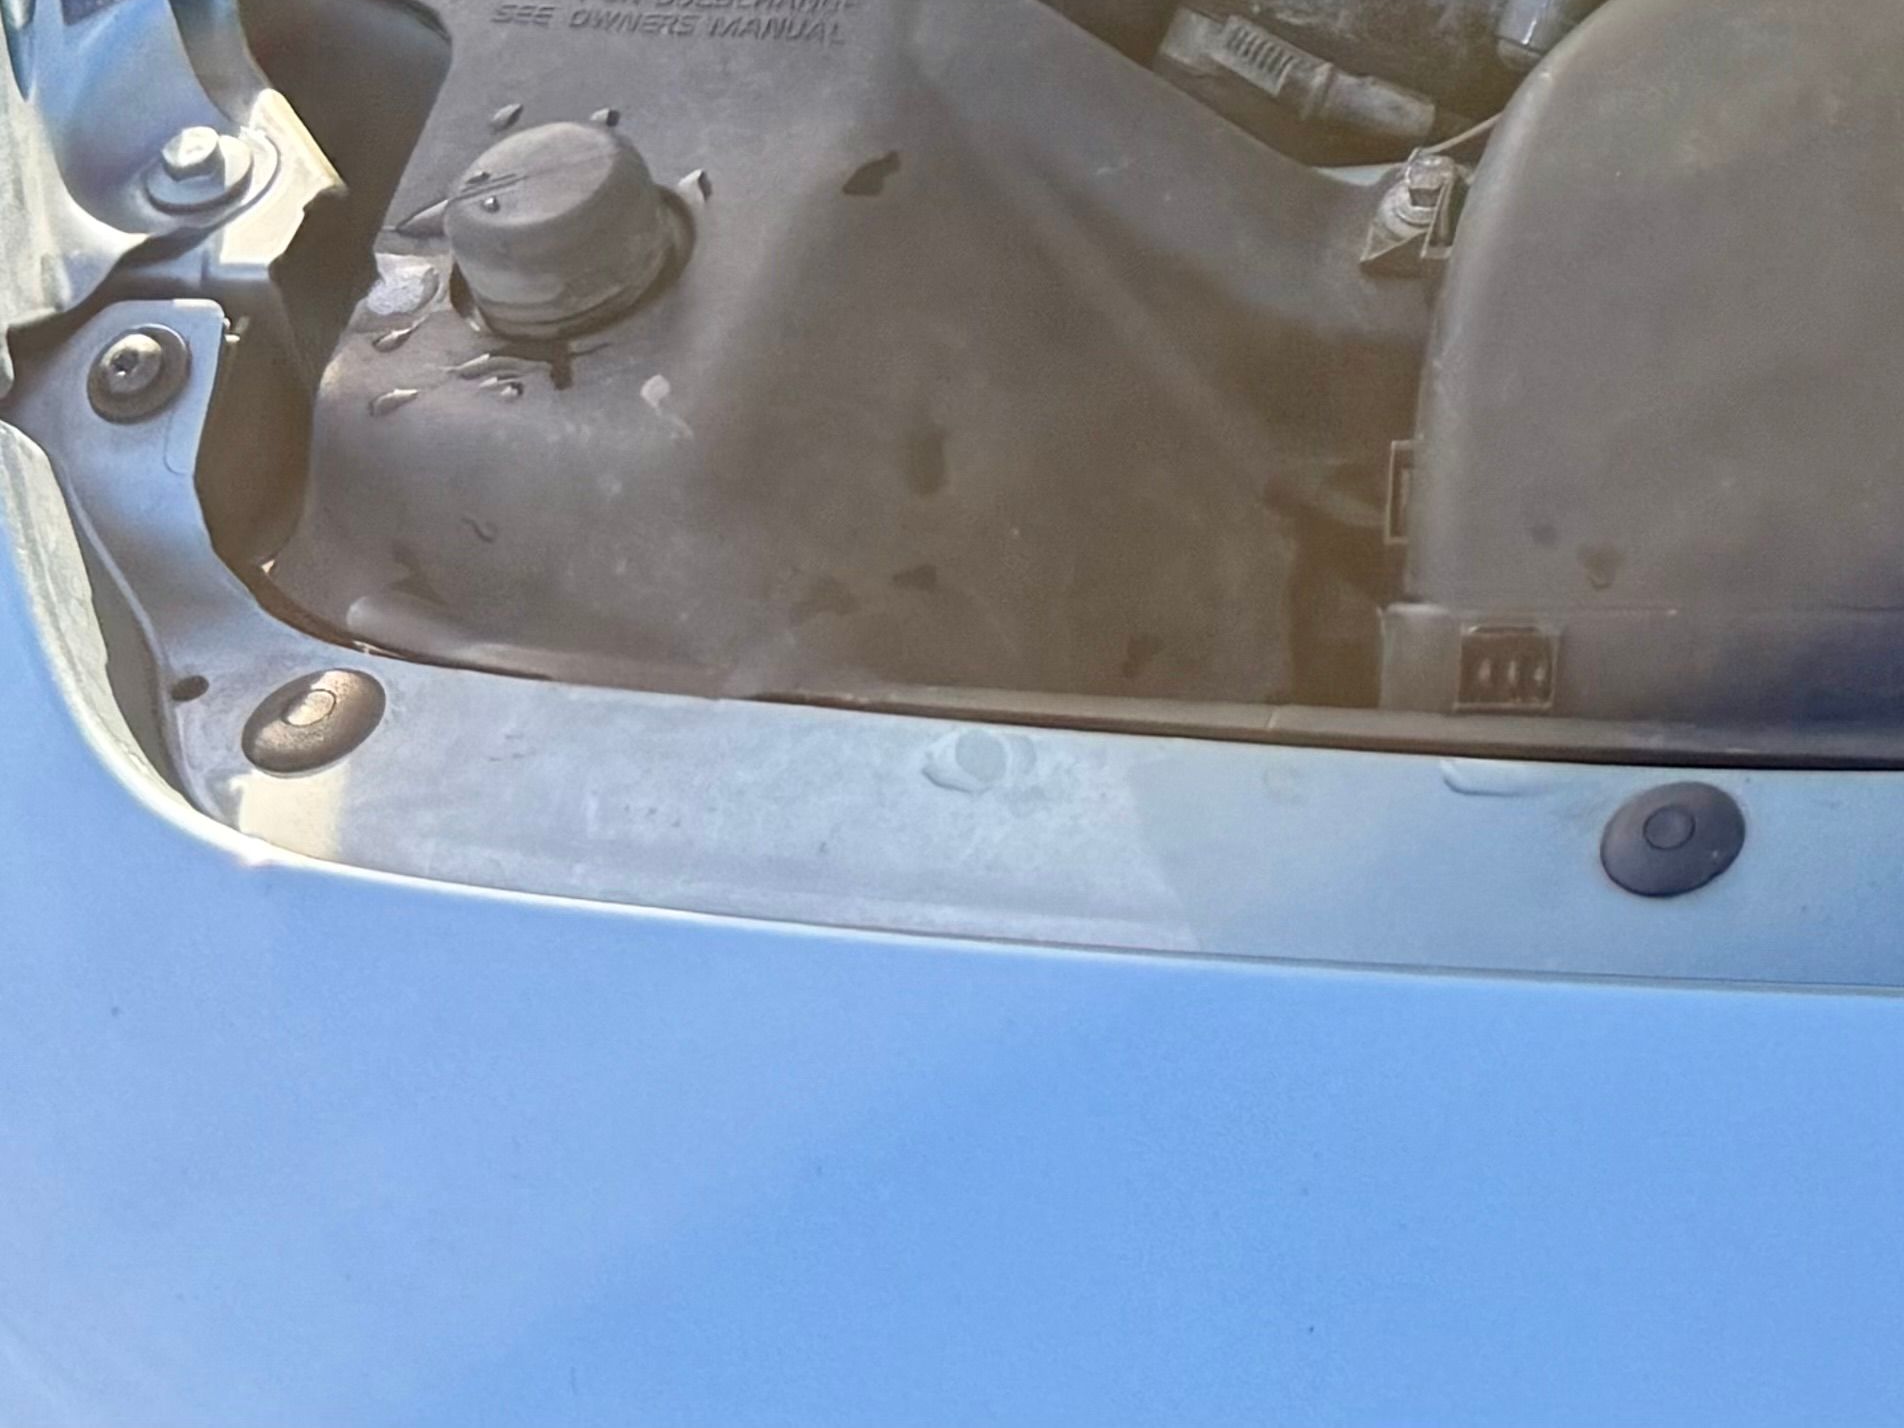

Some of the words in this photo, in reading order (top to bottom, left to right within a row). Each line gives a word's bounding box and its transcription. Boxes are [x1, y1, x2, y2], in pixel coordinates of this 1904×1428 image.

[489, 4, 558, 29] SEE
[569, 8, 702, 38] OWNERS
[708, 14, 846, 46] MANUAL
